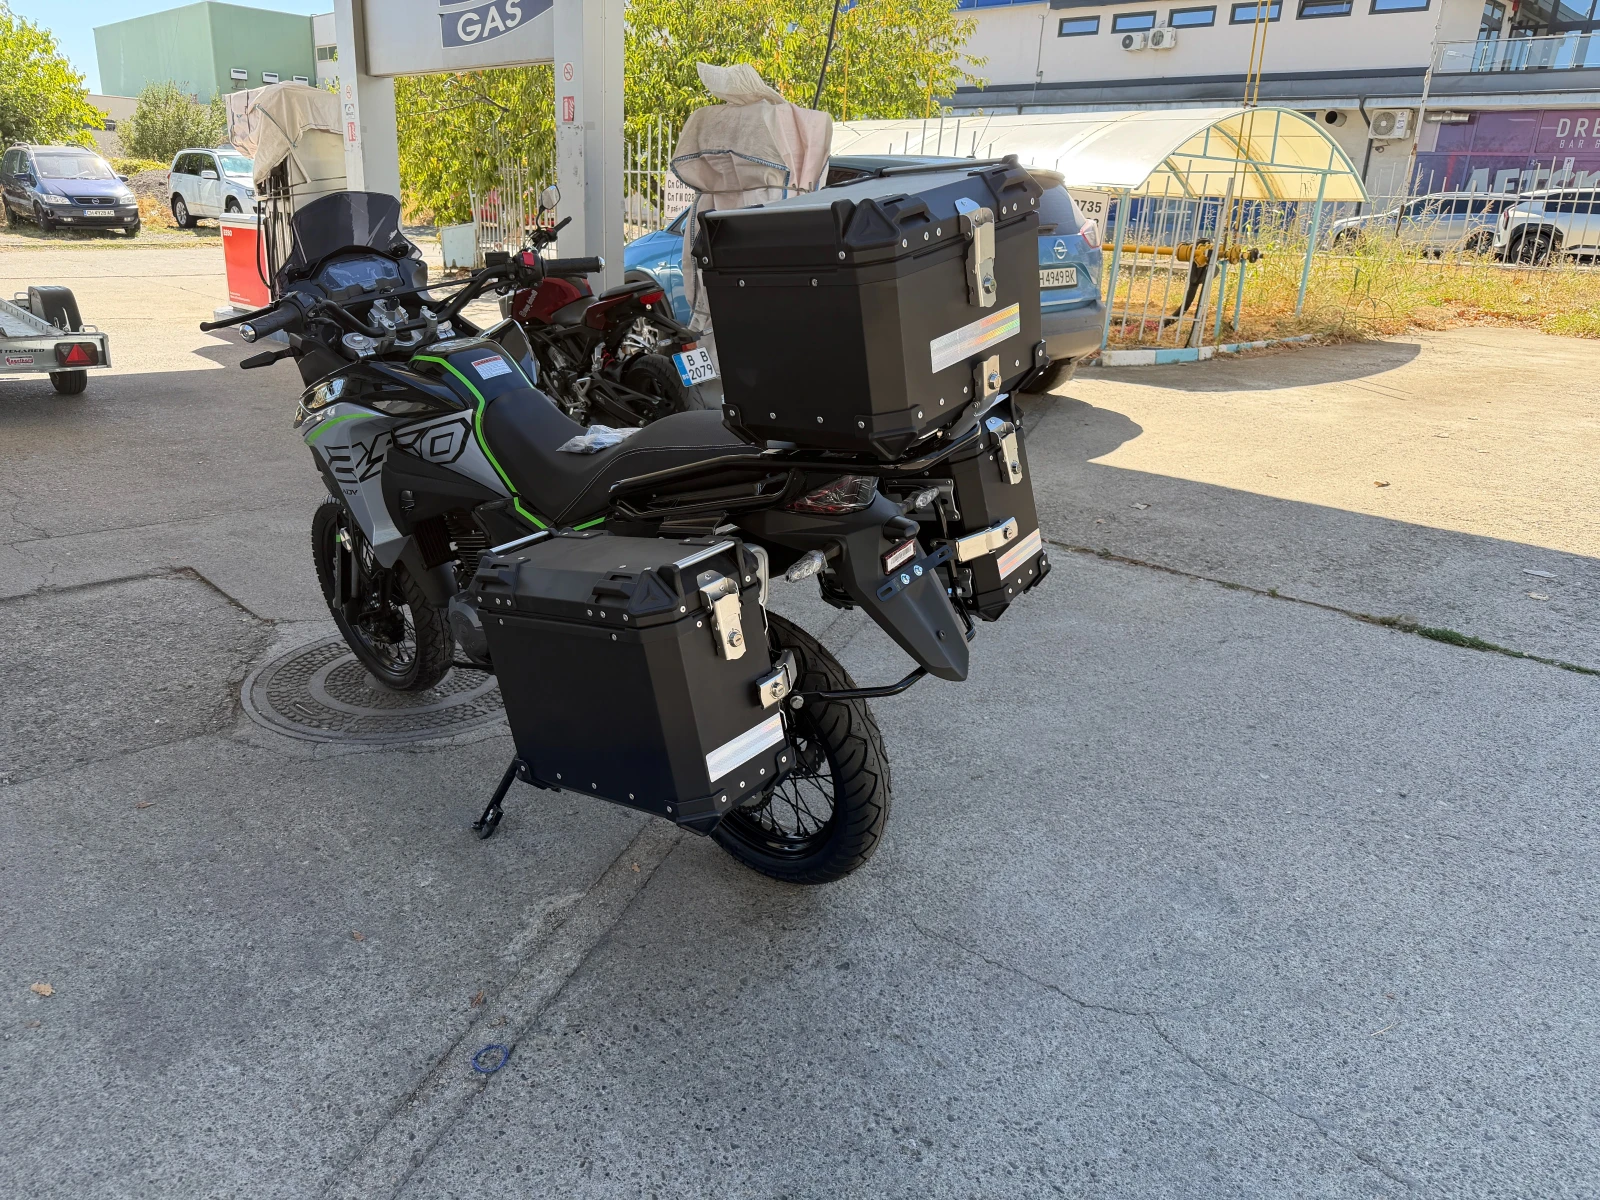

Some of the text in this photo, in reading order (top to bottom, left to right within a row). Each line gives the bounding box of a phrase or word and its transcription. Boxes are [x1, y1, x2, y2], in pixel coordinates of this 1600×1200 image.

[457, 0, 522, 41] GAS
[1559, 139, 1585, 148] BAR
[686, 351, 709, 366] B B
[689, 363, 713, 380] 2079
